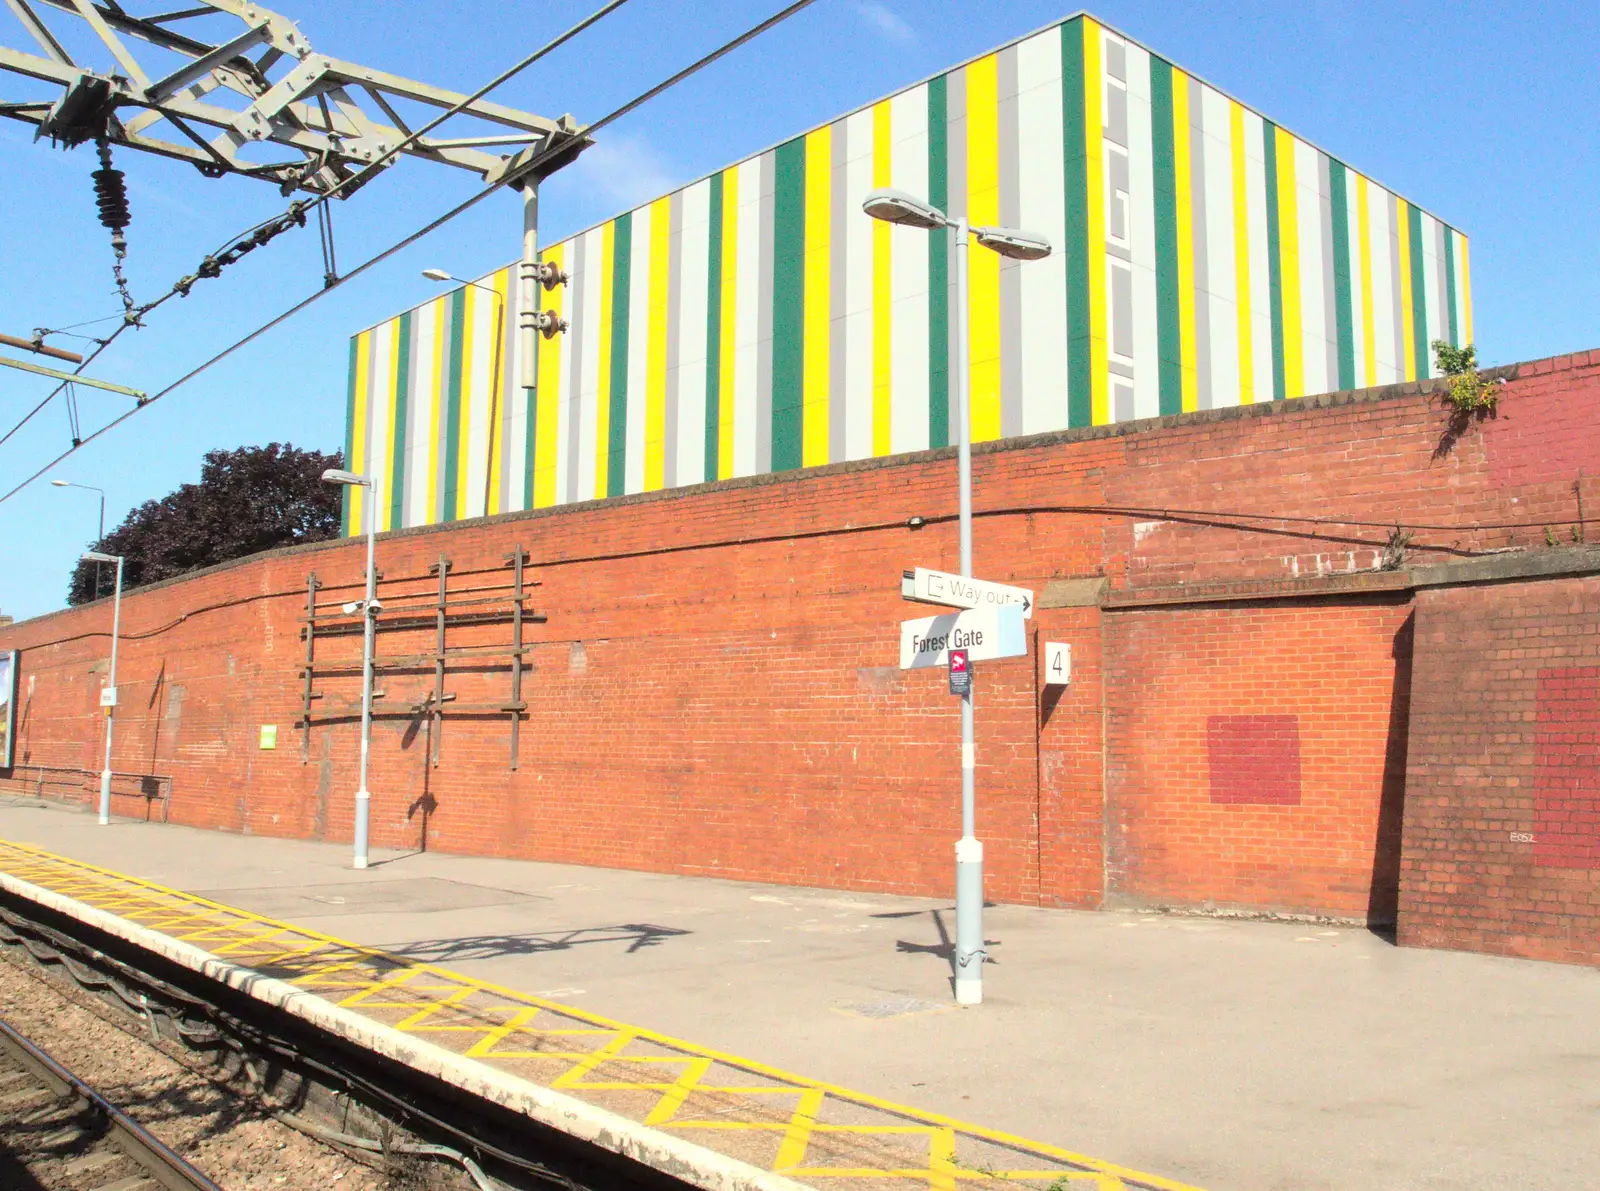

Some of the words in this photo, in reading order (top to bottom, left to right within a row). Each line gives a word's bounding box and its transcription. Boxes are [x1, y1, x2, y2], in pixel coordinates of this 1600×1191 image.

[950, 579, 982, 604] Way
[986, 589, 1011, 605] out
[913, 631, 950, 654] Forest
[954, 628, 983, 648] Gate
[1052, 650, 1063, 677] 4
